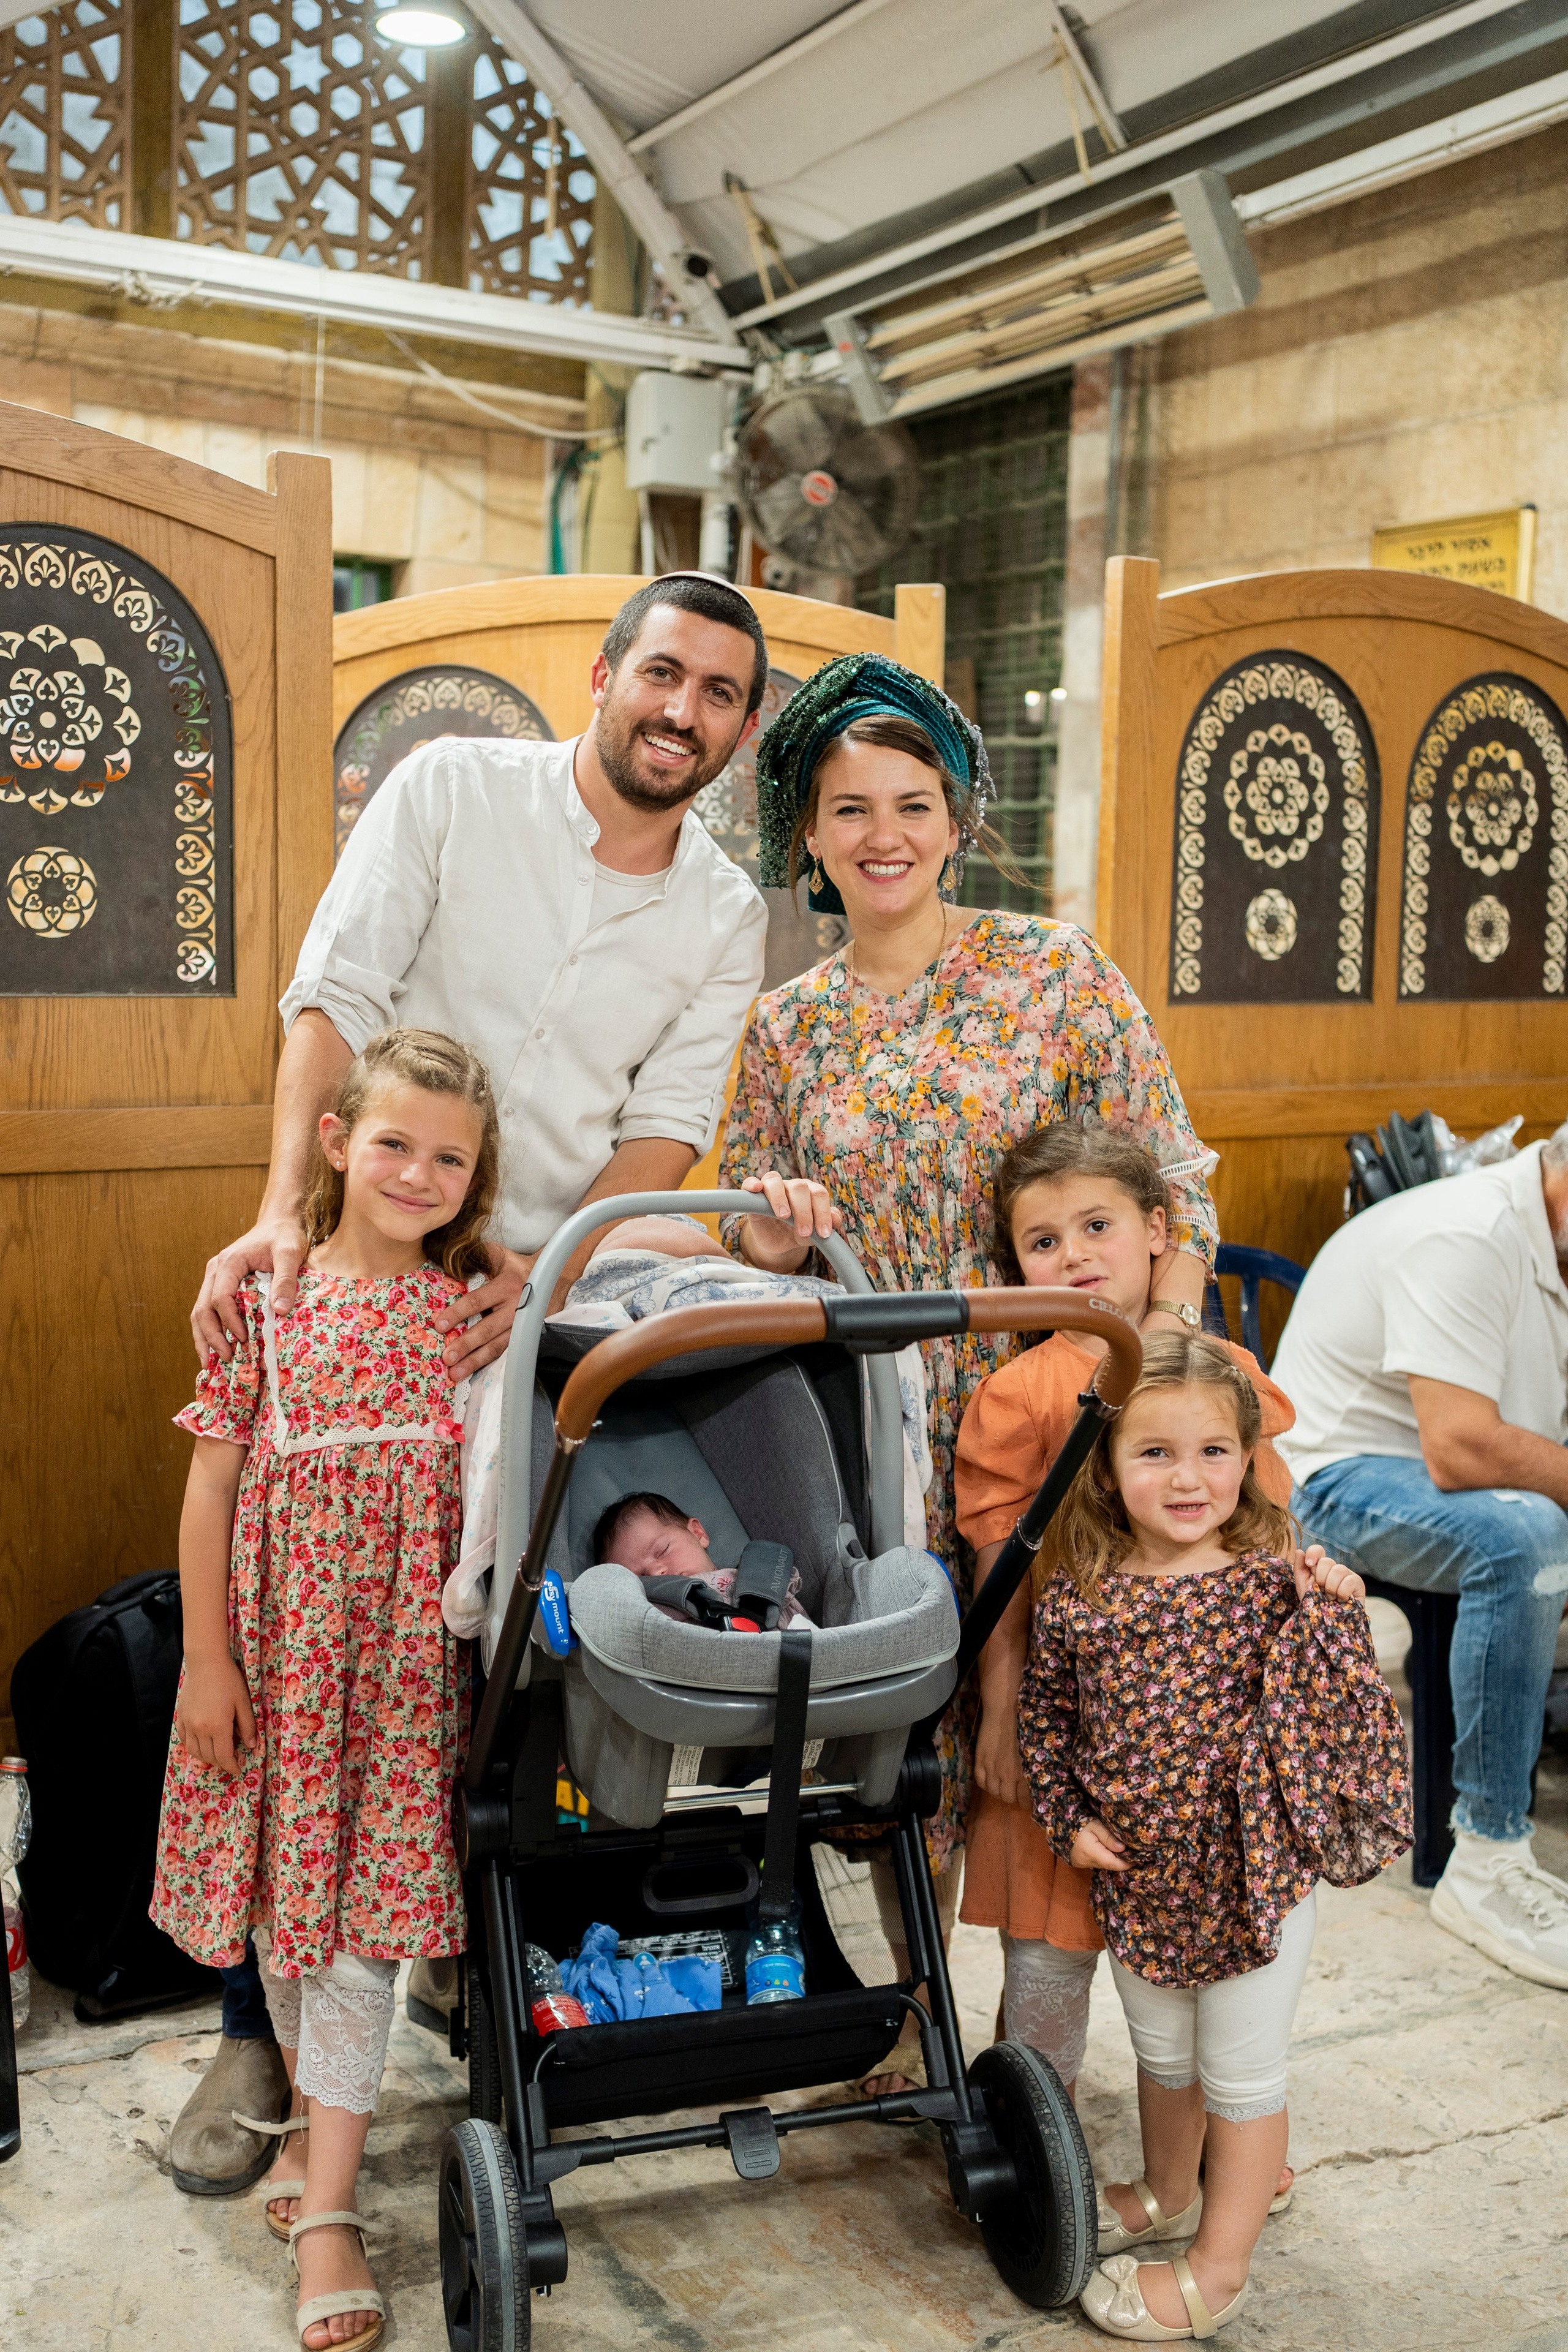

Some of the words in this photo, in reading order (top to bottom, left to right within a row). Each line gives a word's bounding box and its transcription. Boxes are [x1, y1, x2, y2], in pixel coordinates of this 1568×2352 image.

[500, 1384, 510, 1493] AVIONAUT
[771, 1547, 788, 1594] AVIONAUT
[552, 1602, 565, 1634] mount
